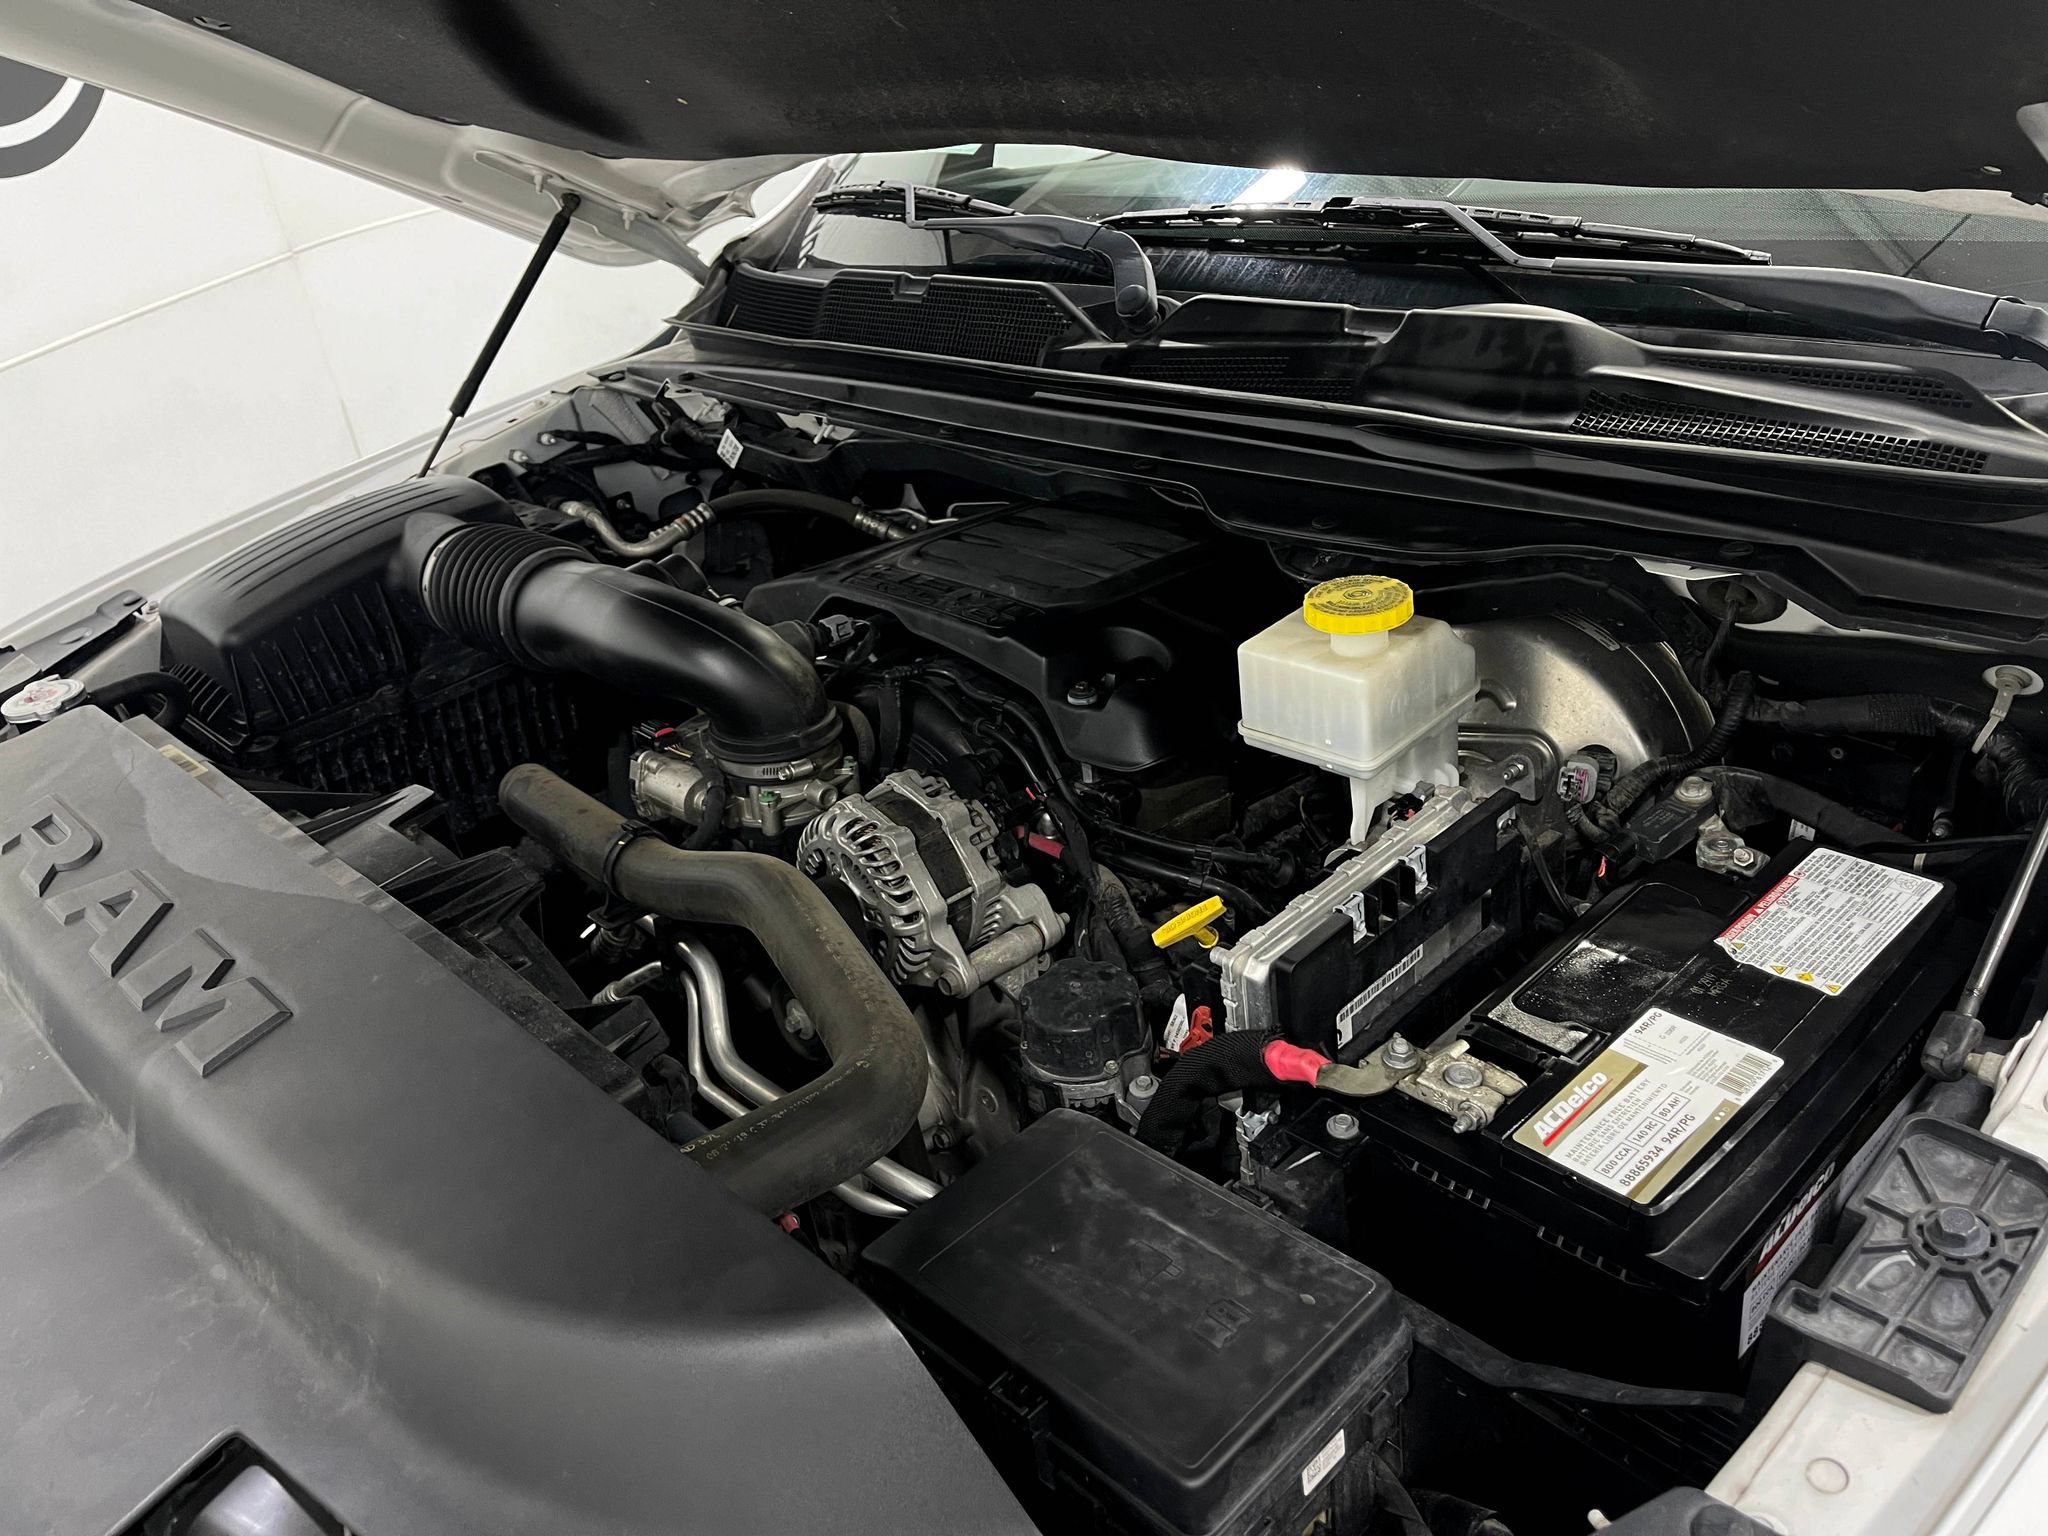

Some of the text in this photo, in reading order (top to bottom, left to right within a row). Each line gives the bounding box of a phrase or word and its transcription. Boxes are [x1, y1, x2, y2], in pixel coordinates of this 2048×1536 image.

[1, 797, 294, 1077] RAM
[1633, 1011, 1664, 1035] 94R/PG
[1531, 1070, 1609, 1141] ACDelco
[1564, 1117, 1610, 1159] MAINTENANCE
[1607, 1103, 1625, 1118] FREE
[1622, 1078, 1651, 1103] BATTERY
[1599, 1159, 1618, 1174] 800
[1612, 1145, 1632, 1161] CCA
[1631, 1129, 1649, 1143] 140
[1643, 1120, 1657, 1130] RC
[1657, 1107, 1671, 1117] 80
[1618, 1113, 1698, 1187] 88865934 94R/PG
